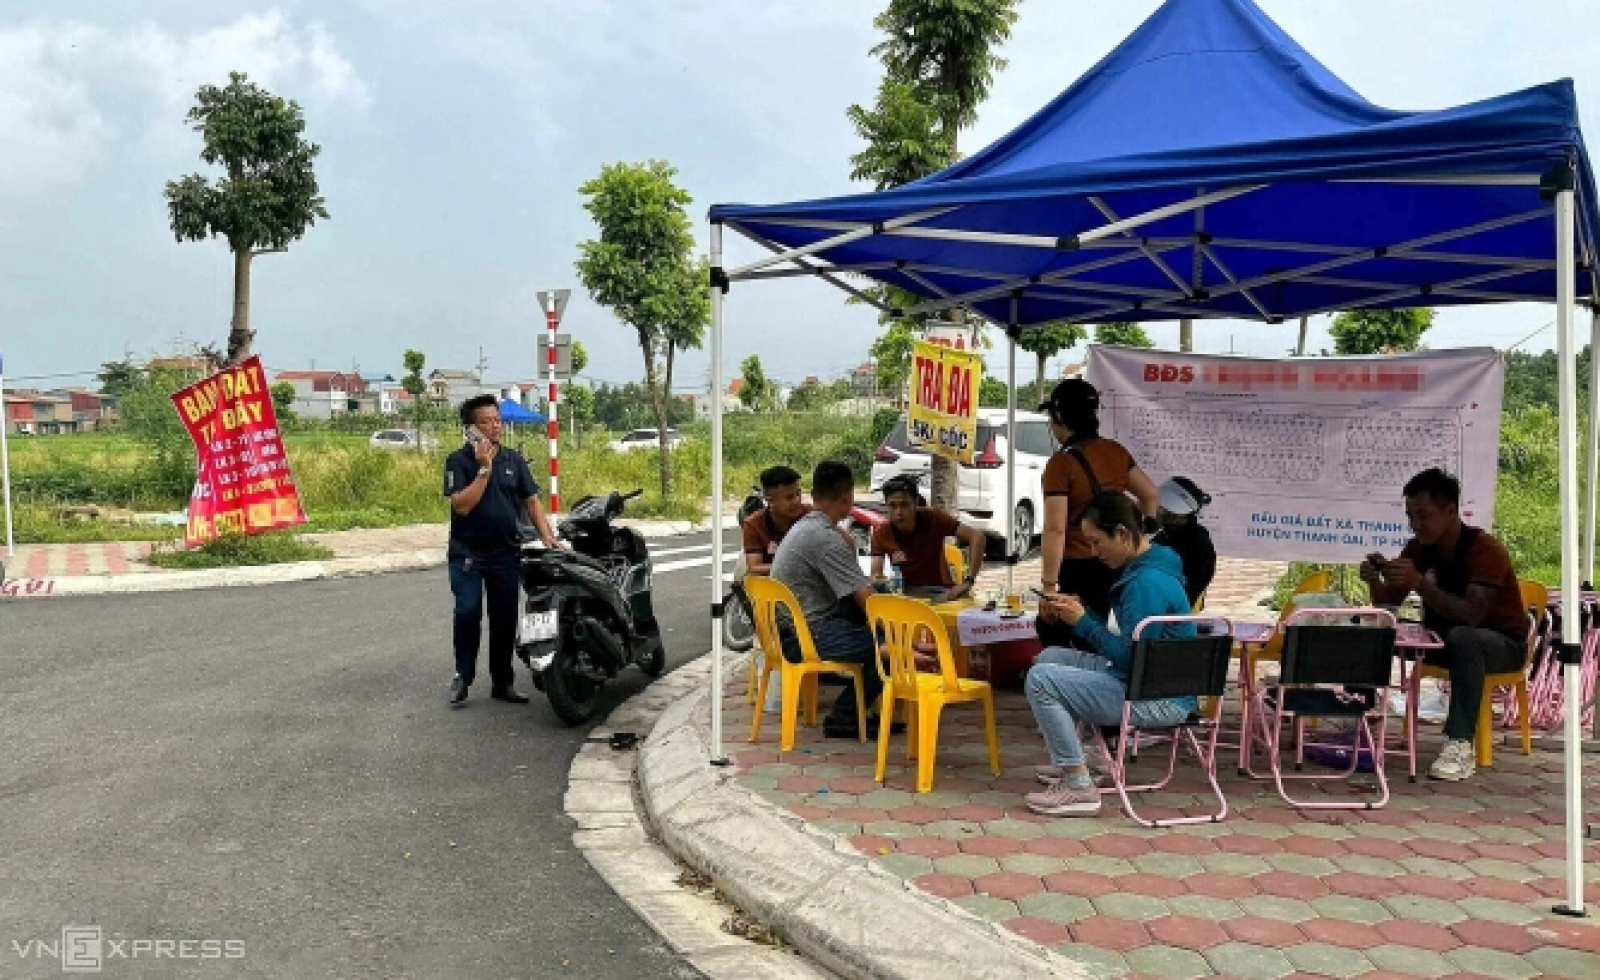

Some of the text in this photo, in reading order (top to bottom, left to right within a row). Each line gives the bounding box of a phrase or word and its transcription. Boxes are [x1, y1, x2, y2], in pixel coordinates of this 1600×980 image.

[1143, 363, 1195, 384] BĐS
[1357, 519, 1402, 532] THANH
[1294, 531, 1337, 544] THANH
[1371, 536, 1388, 547] TP
